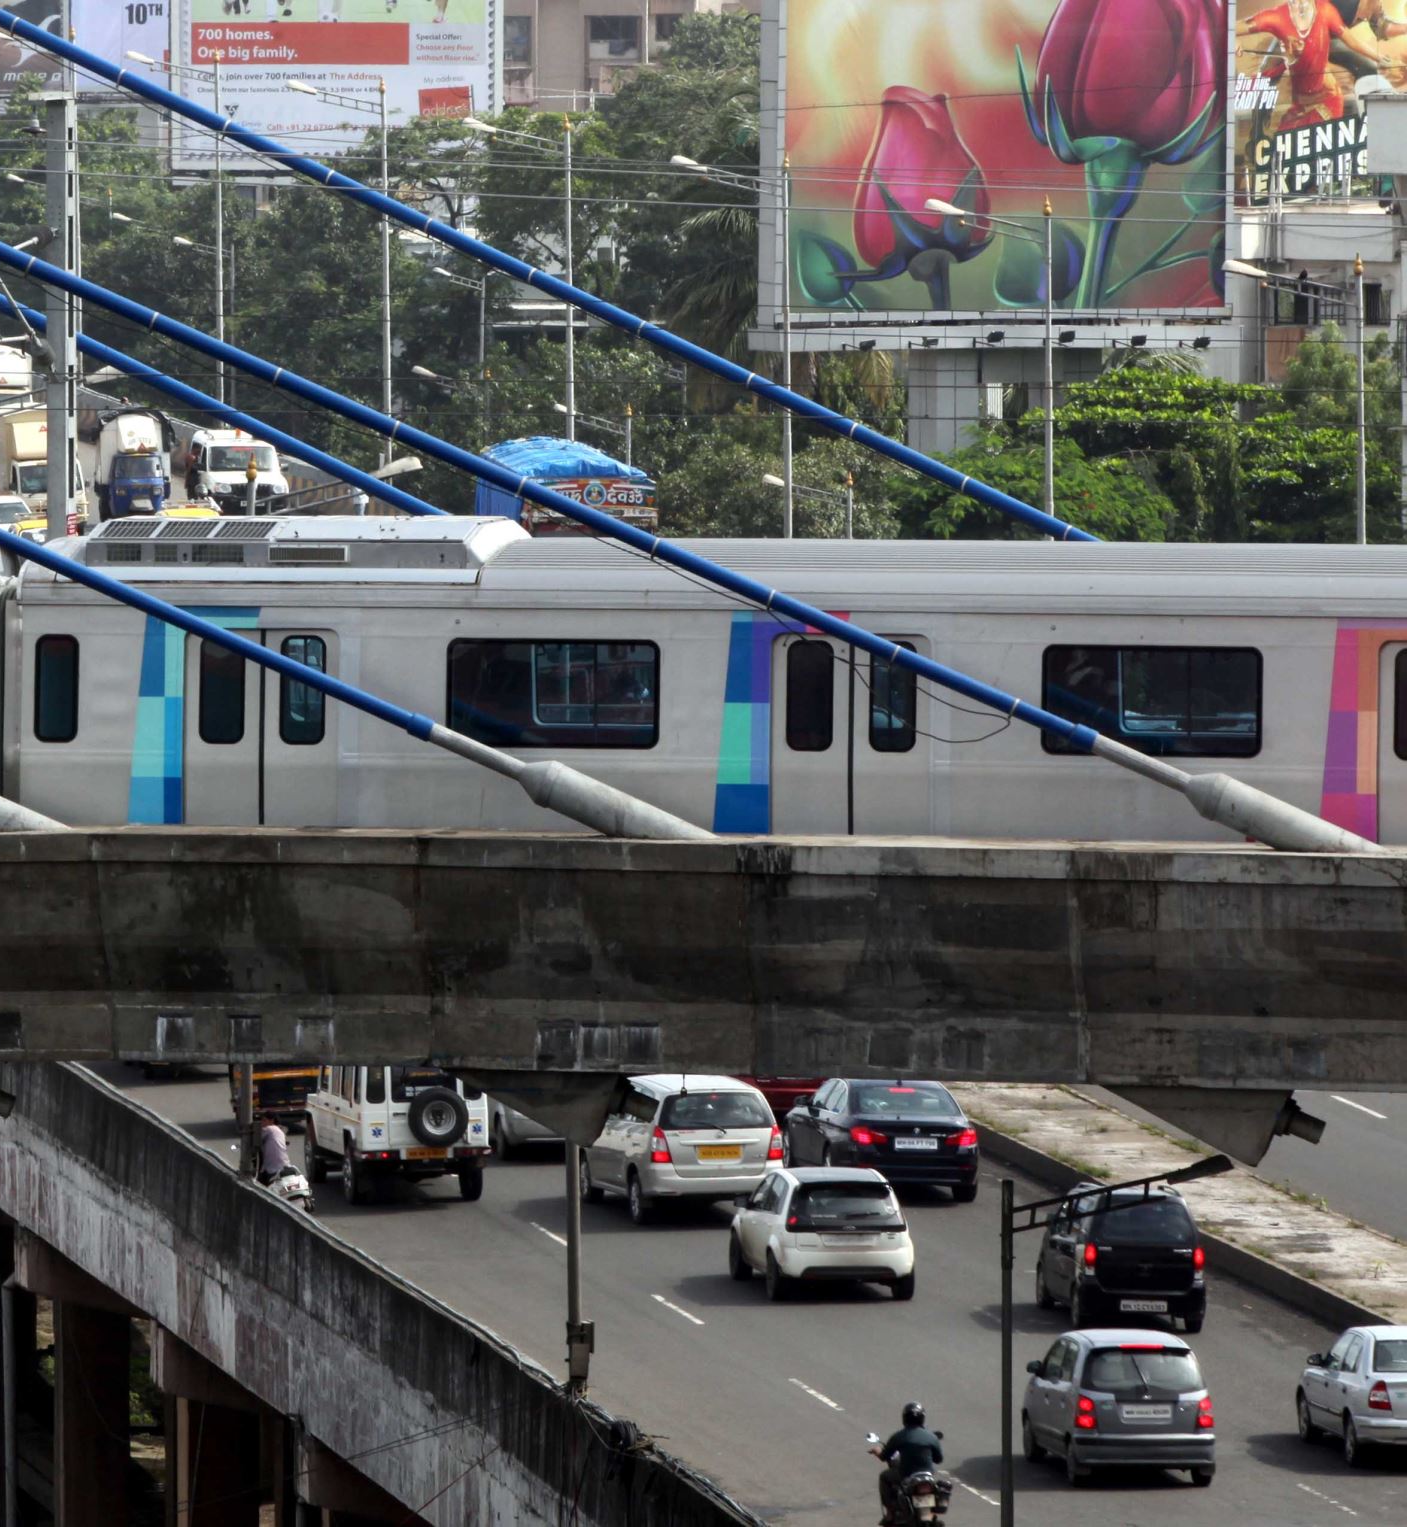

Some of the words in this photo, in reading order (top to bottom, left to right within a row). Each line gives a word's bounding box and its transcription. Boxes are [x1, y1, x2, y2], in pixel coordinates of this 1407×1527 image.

[124, 3, 163, 25] 10TH
[198, 28, 223, 40] 700
[225, 28, 274, 40] homes.
[228, 46, 250, 61] big
[253, 46, 298, 61] family.
[225, 72, 242, 82] join
[265, 72, 281, 80] 700
[282, 72, 316, 80] families
[329, 72, 346, 80] The
